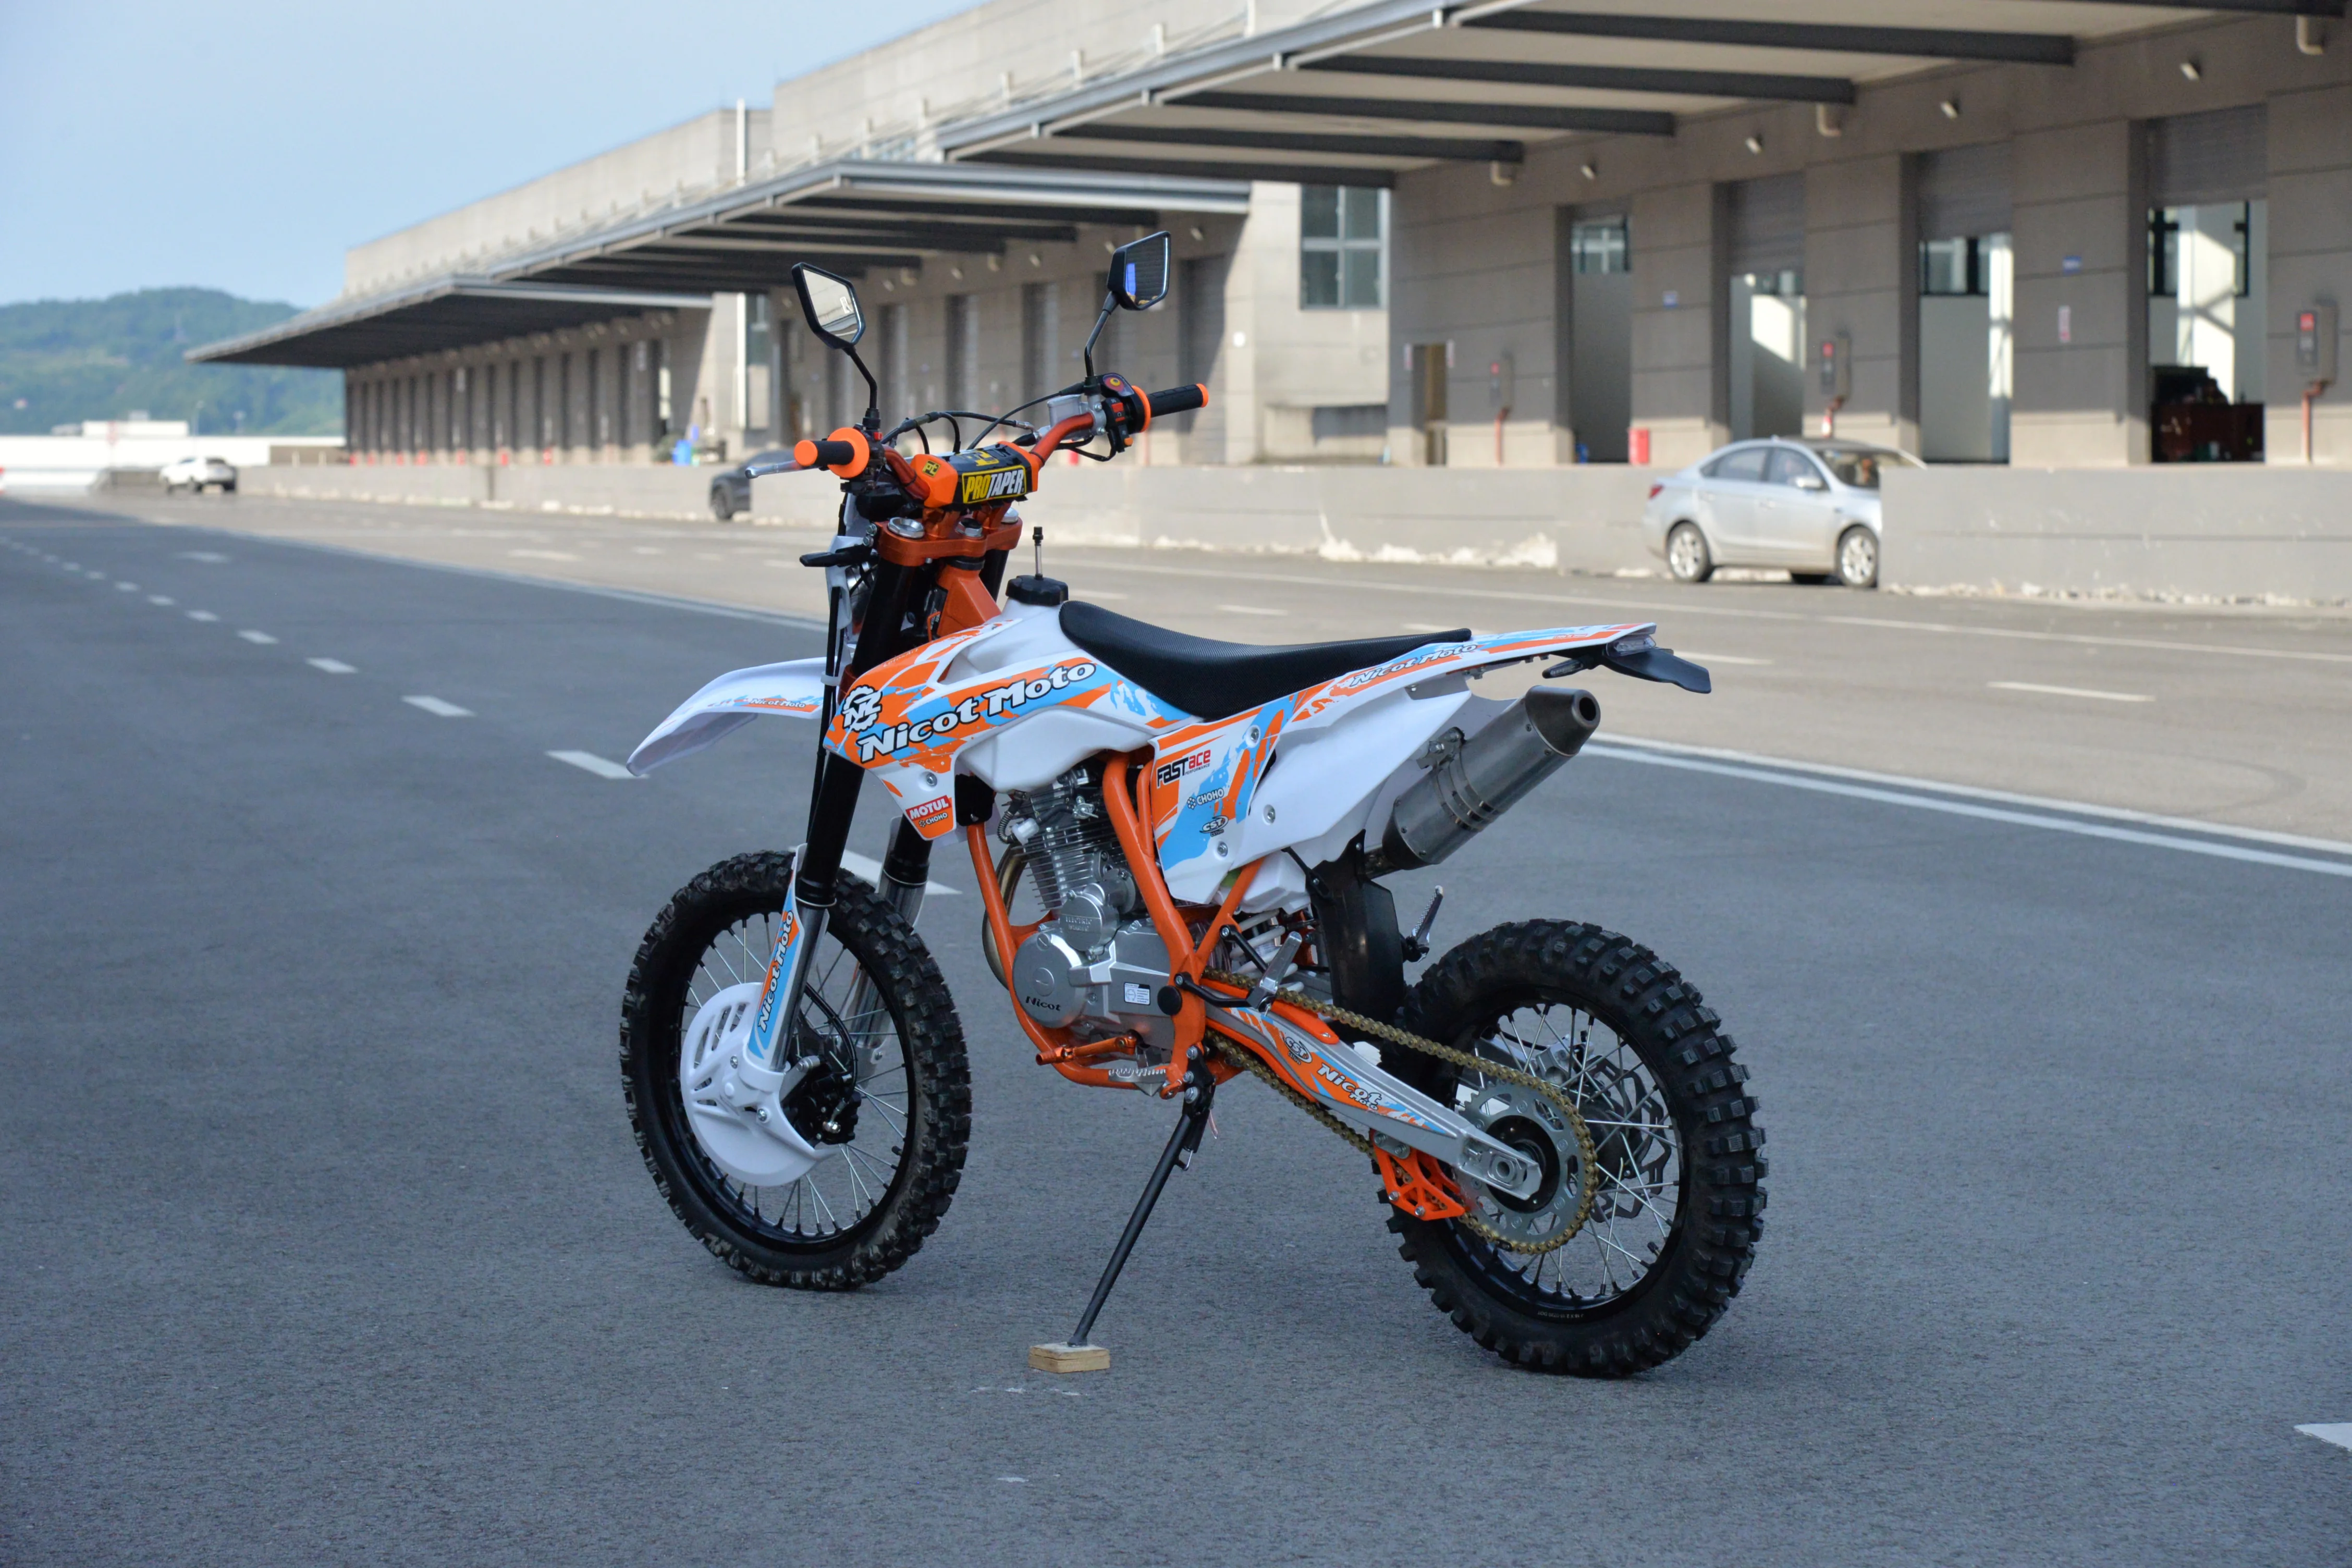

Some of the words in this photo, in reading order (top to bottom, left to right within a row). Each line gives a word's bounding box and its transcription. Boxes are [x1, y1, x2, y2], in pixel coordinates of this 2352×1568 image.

[965, 469, 1024, 503] PROTAPER
[1349, 657, 1418, 687] Nicot
[1418, 644, 1477, 665] Moto
[749, 698, 780, 706] Nicot
[779, 700, 806, 708] Moto
[856, 696, 979, 763] Nicot
[983, 662, 1097, 716] Moto
[1185, 763, 1210, 775] PERFORMANCE
[1196, 788, 1224, 806] CHOHO
[909, 798, 949, 820] MOTUL
[925, 812, 948, 825] CHOHO
[758, 965, 781, 1033] Nicot
[775, 910, 794, 966] Moto
[1025, 995, 1061, 1012] Nicot
[1317, 1062, 1382, 1106] Nicot
[1349, 1093, 1378, 1111] Moto
